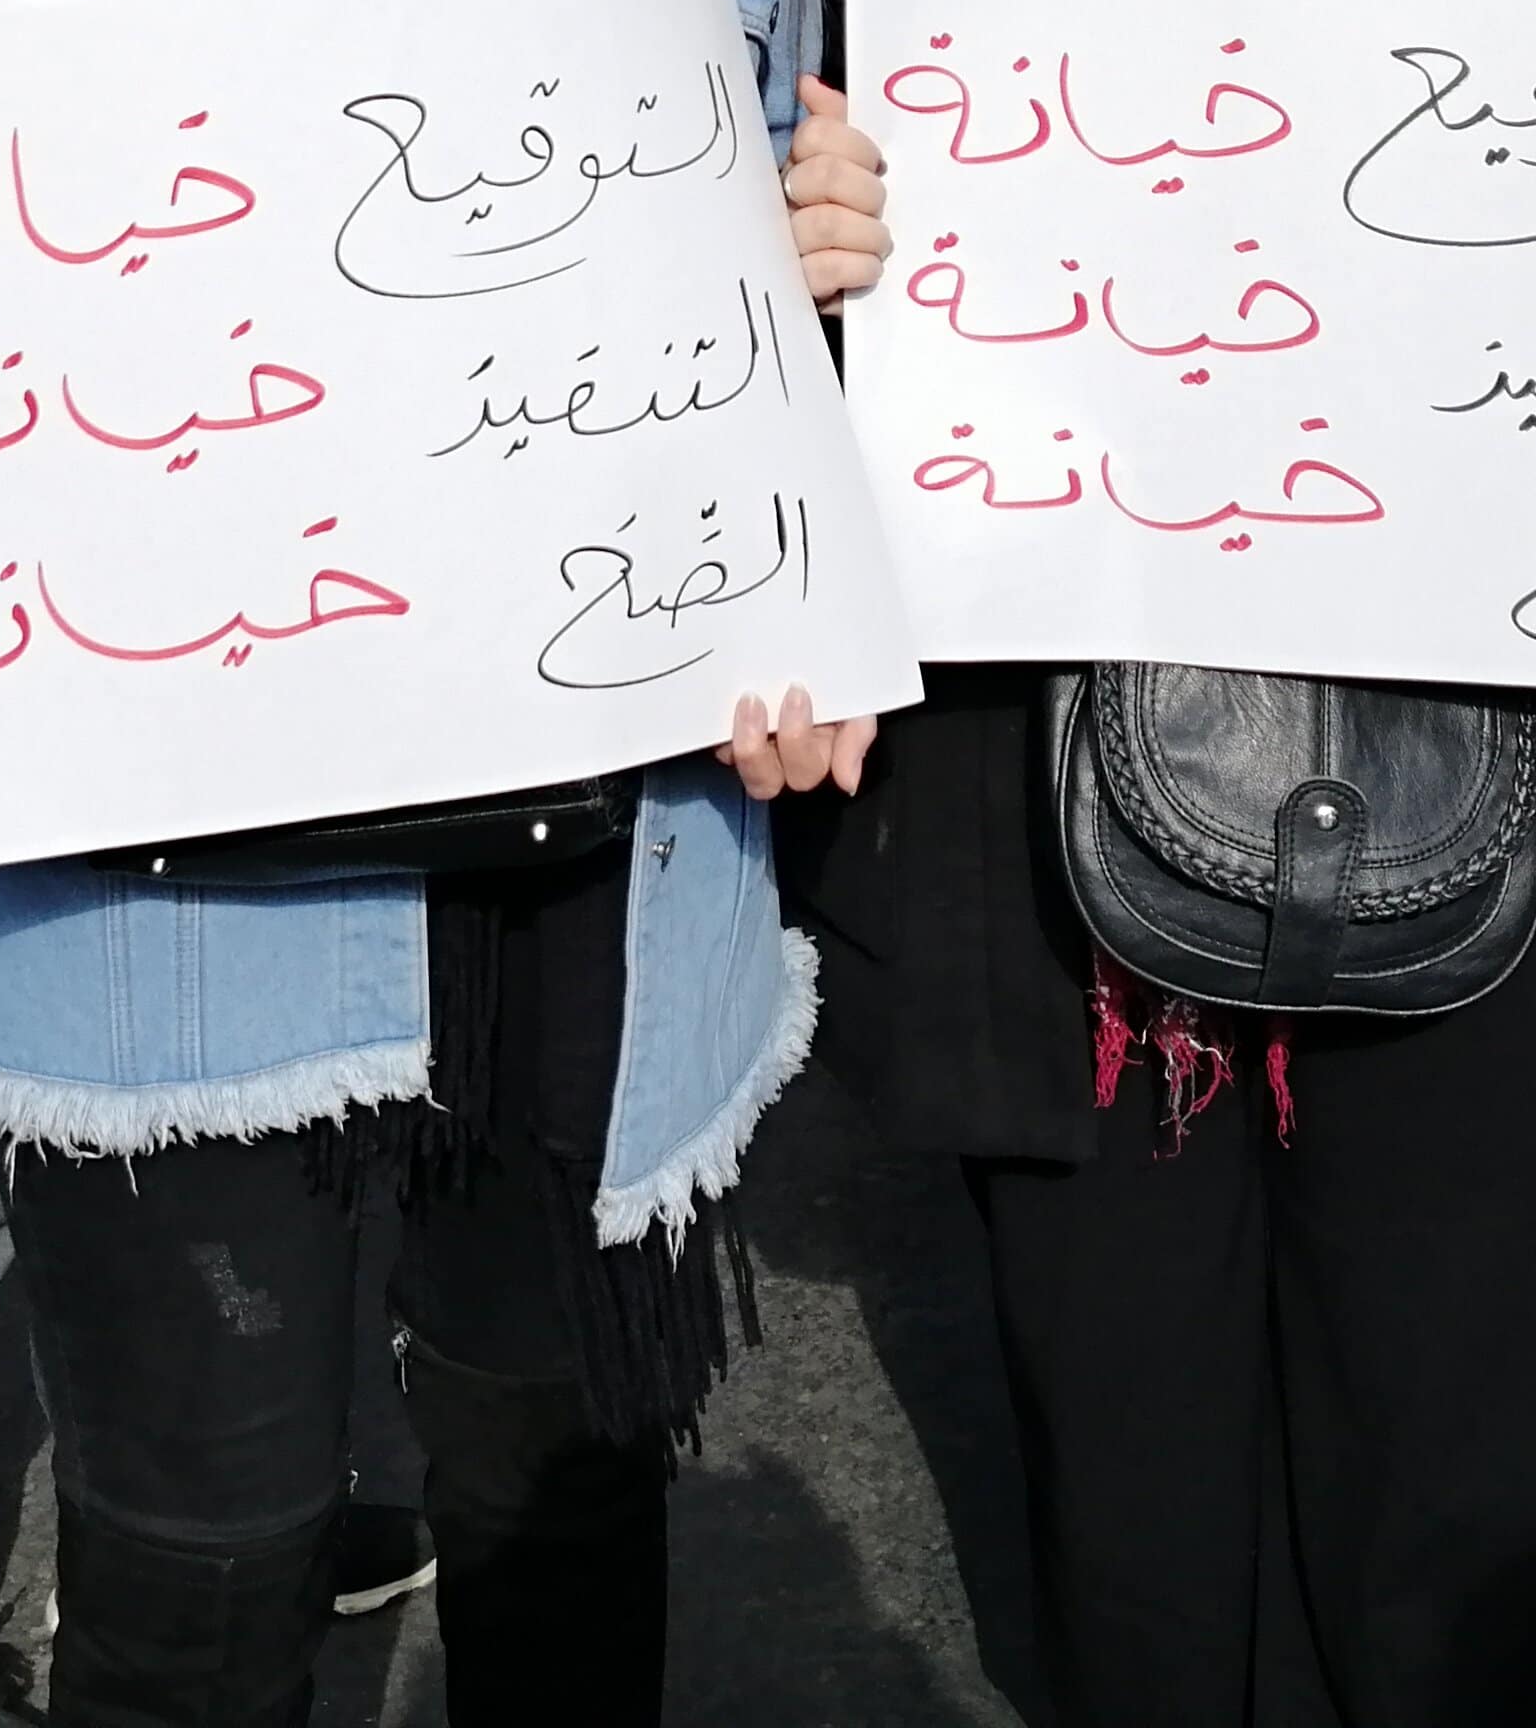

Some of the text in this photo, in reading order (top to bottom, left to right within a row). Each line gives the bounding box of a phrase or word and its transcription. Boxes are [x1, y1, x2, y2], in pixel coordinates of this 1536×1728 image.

[334, 61, 737, 299] التوقيع
[883, 32, 1293, 195] خيانة
[426, 278, 789, 459] التنفيذ
[906, 233, 1321, 385] خيانة
[914, 418, 1386, 552] خيانة
